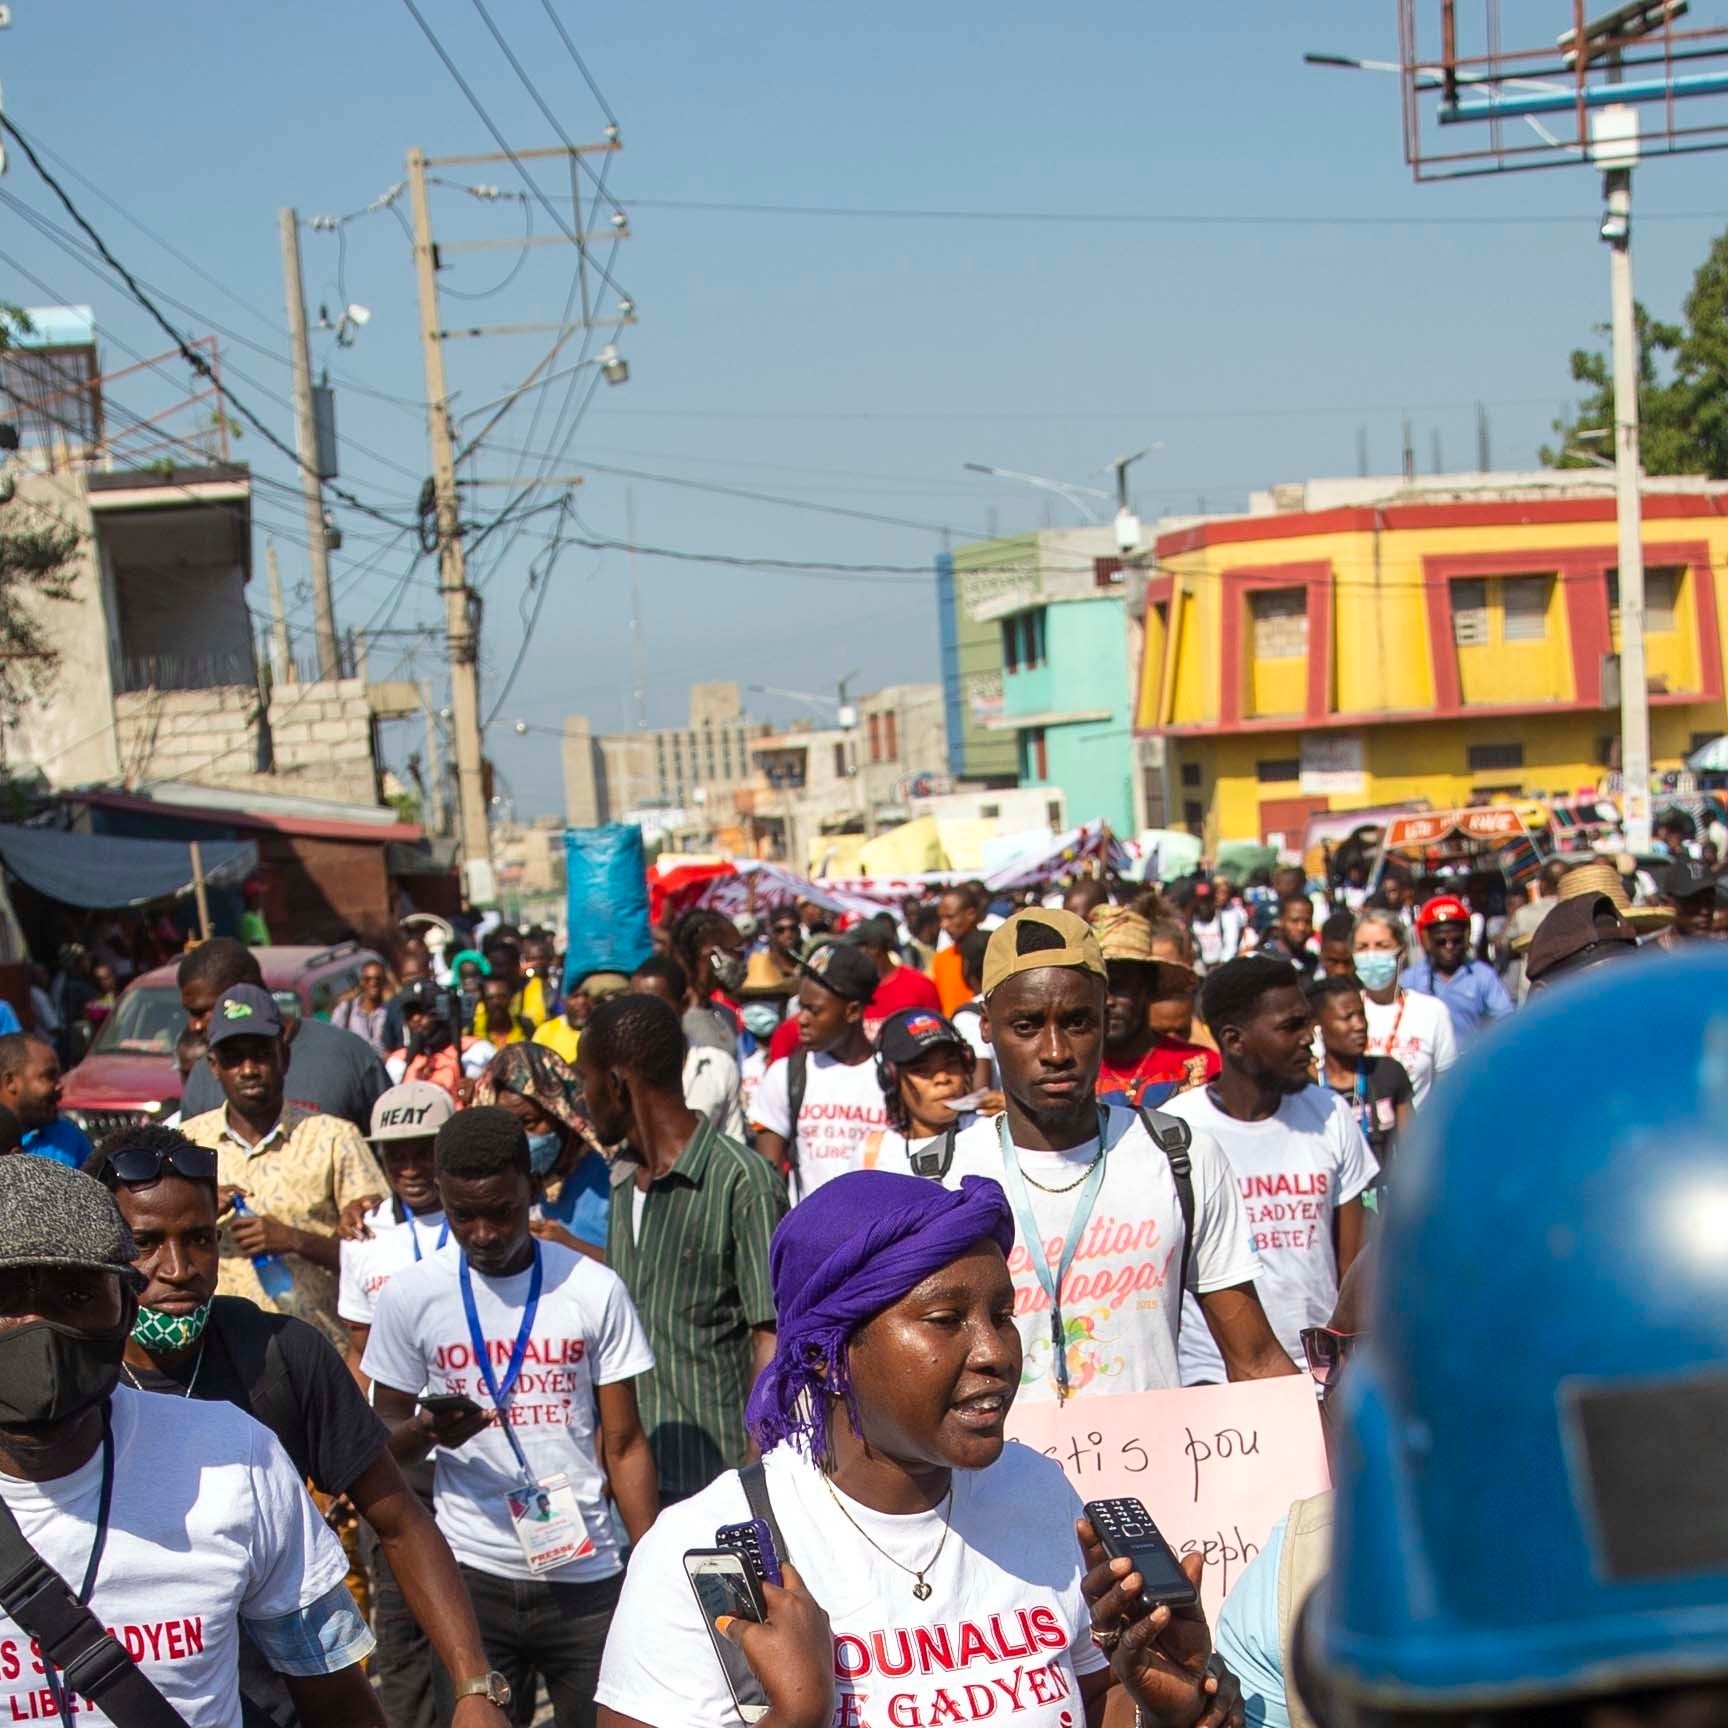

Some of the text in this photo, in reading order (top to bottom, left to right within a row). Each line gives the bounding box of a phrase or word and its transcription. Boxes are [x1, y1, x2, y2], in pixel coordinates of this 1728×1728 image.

[379, 1103, 433, 1128] HEAT
[1236, 1172, 1328, 1200] UNALIS
[1012, 1427, 1261, 1503] stis pou
[1169, 1526, 1261, 1598] seph
[104, 1616, 204, 1664] DYEN
[832, 1606, 1069, 1681] OUNALIS
